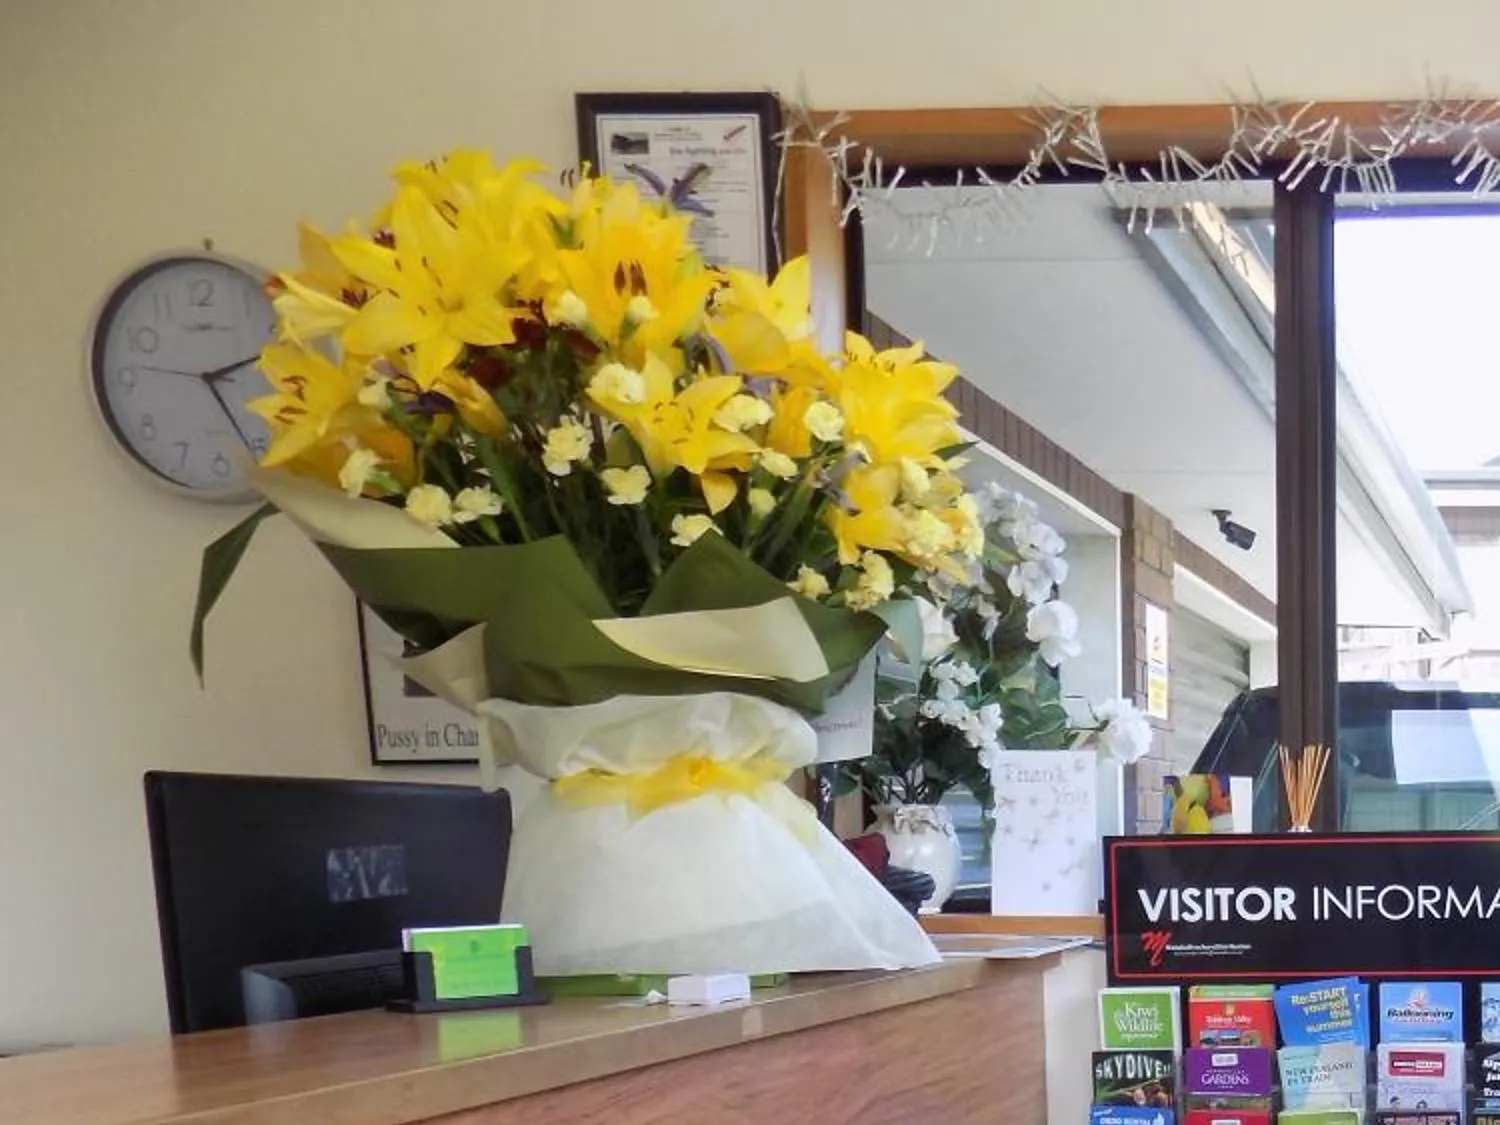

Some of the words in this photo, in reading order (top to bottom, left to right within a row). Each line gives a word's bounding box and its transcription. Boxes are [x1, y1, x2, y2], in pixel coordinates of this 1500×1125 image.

[153, 292, 172, 320] 11
[186, 278, 215, 308] 12
[127, 326, 159, 354] 10
[141, 413, 158, 442] 8
[171, 441, 190, 474] 7
[212, 451, 231, 478] 6
[377, 723, 420, 754] Pussy
[425, 721, 439, 748] in
[1137, 886, 1298, 924] VISITOR
[1114, 1013, 1166, 1033] Wildlife
[1200, 1072, 1250, 1086] GARDENS
[1300, 1073, 1332, 1085] TRAIN
